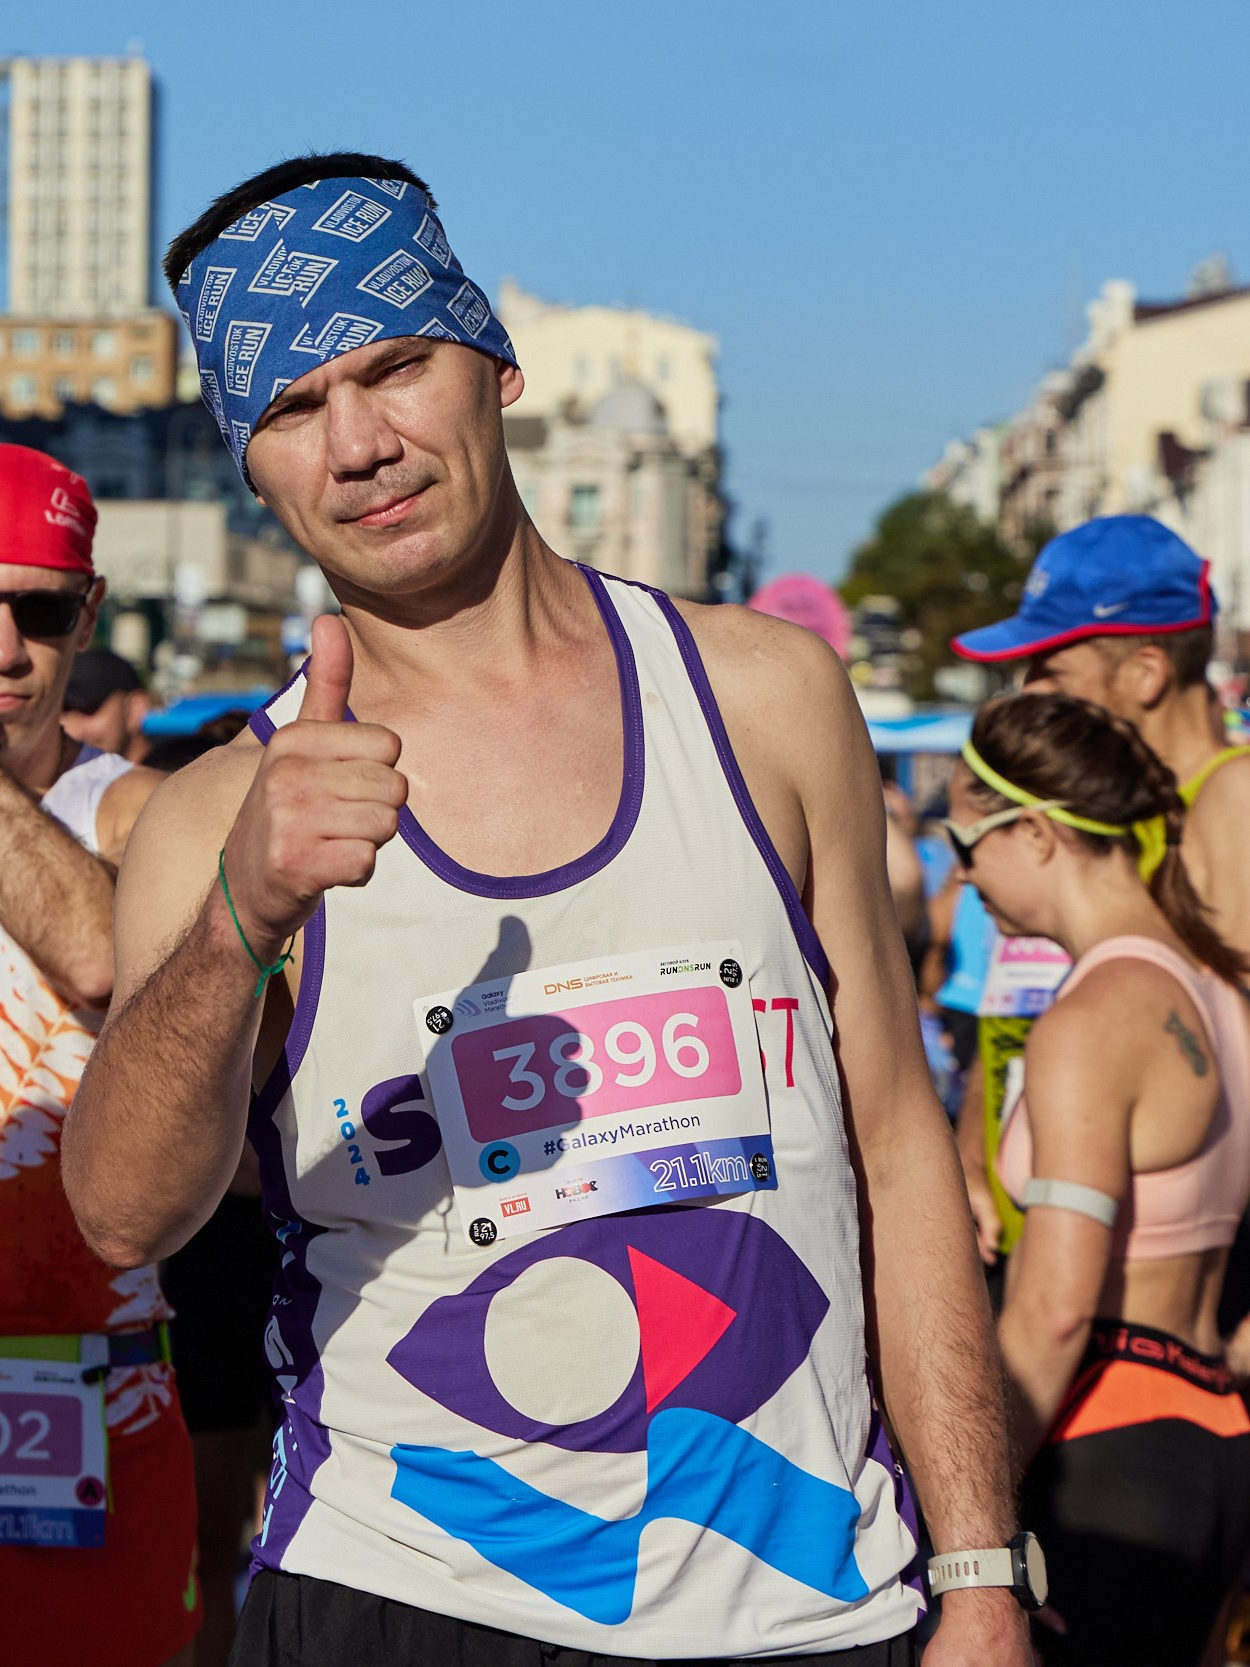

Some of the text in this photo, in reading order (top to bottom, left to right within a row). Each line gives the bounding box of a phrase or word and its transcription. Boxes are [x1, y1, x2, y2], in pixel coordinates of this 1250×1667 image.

[237, 211, 265, 235] ICE
[322, 195, 364, 229] VLADIVOSTOK
[339, 200, 385, 237] ICE RUN
[367, 255, 414, 291] VLADIVOSTOK
[382, 264, 428, 303] ICE RUN
[197, 272, 216, 334] VLADIVOSTOK
[203, 273, 230, 335] ICE RUN
[462, 315, 480, 336] ICE
[227, 327, 244, 388] VLADIVOSTOK
[234, 327, 264, 390] ICE RUN
[543, 978, 584, 995] DNS
[583, 973, 613, 982] ЦИФРОВАЯ
[584, 974, 633, 988] БЫТОВАЯ ТЕХНИКА
[660, 962, 711, 976] RUNDNSRUN
[481, 989, 504, 1000] Galaxy
[492, 1012, 710, 1111] 3896
[333, 1098, 371, 1185] 2024
[361, 1074, 442, 1176] S
[543, 1112, 701, 1157] #GalaxyMarathon
[650, 1151, 748, 1192] 21.1km
[503, 1200, 527, 1214] VL.RU
[480, 1222, 492, 1233] 21
[480, 1232, 495, 1240] 97,5
